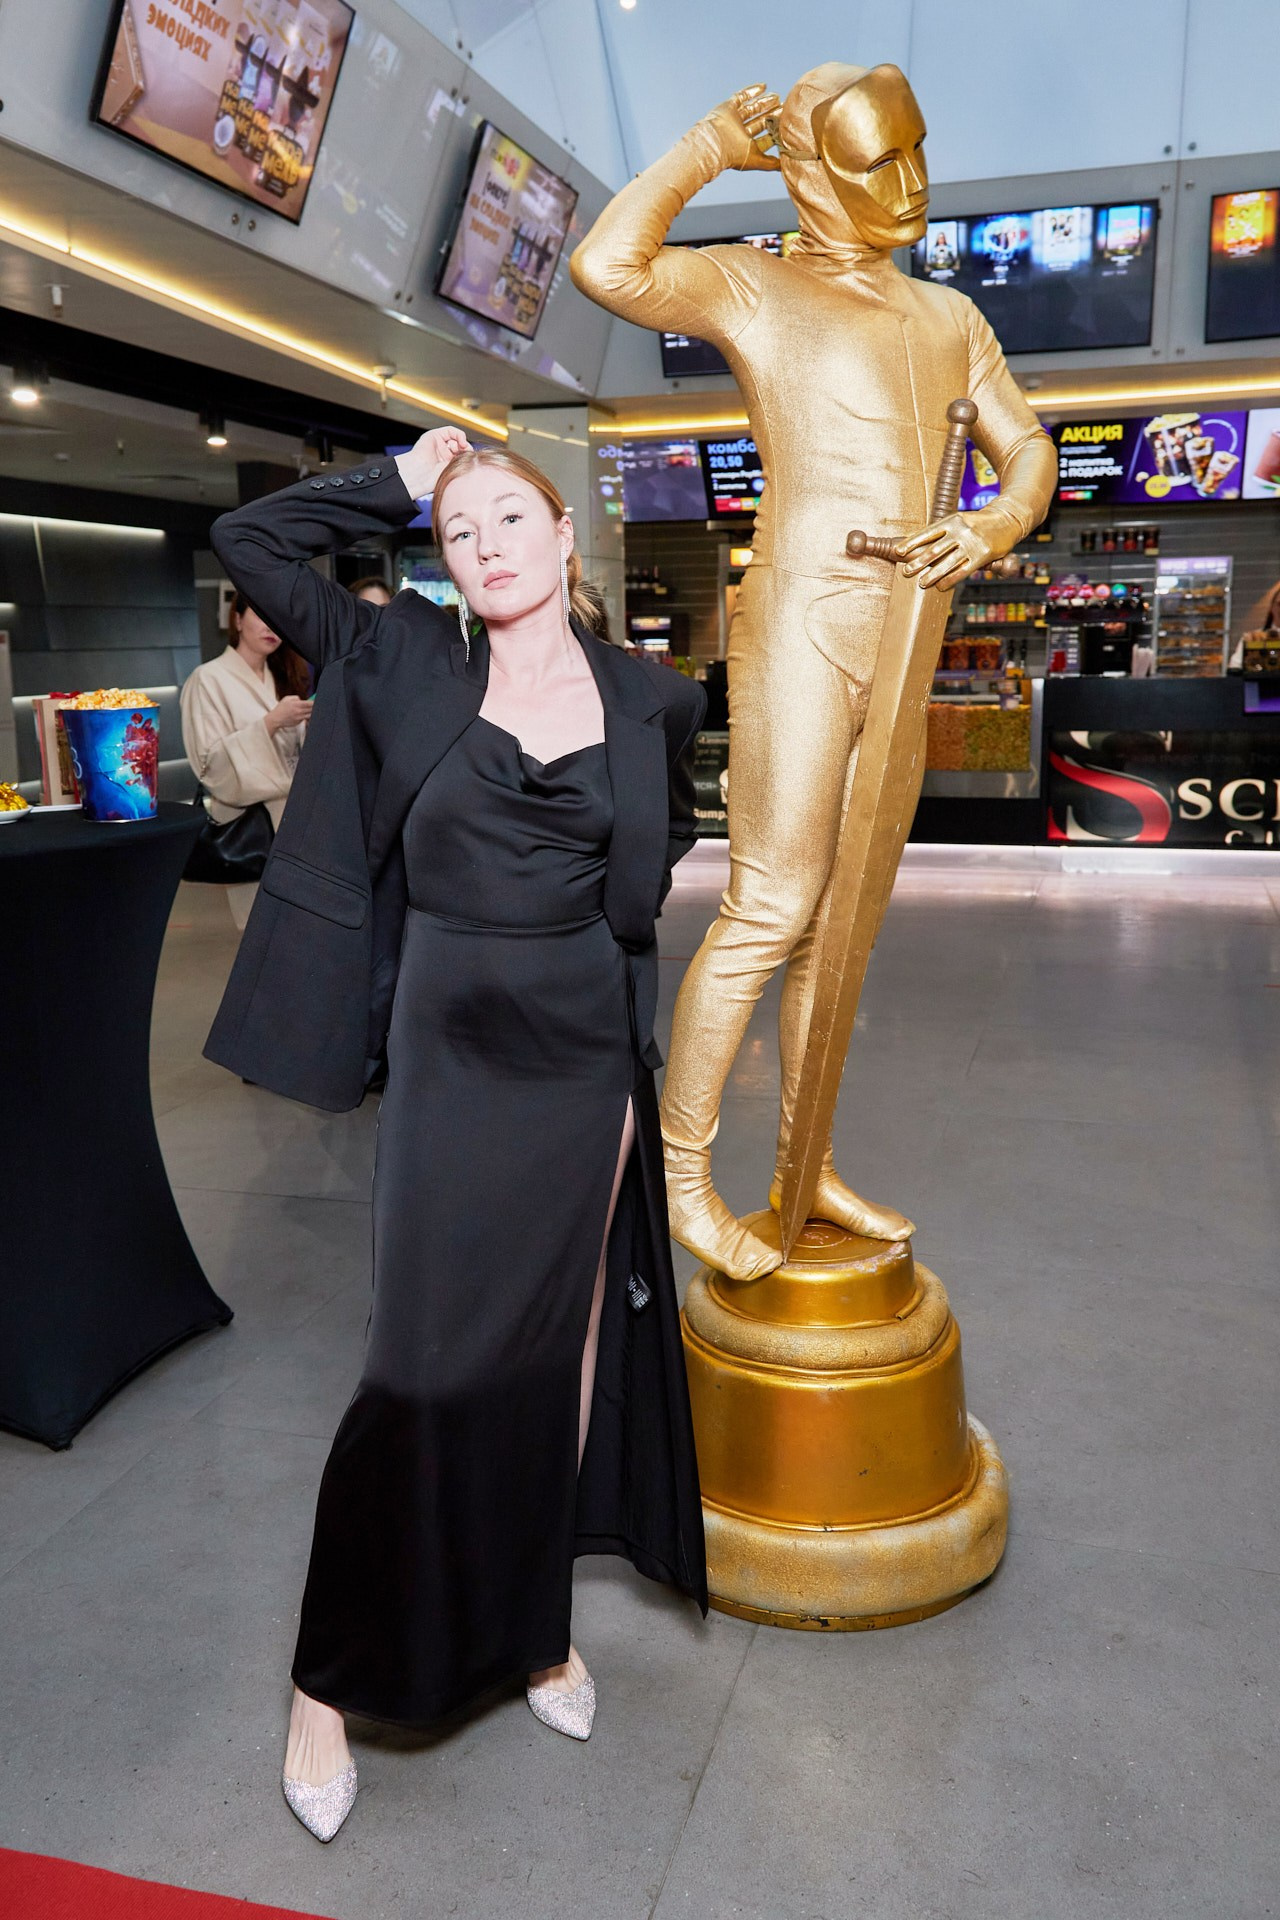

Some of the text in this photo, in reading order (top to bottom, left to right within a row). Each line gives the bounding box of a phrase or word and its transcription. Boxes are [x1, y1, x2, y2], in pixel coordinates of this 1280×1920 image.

[1060, 425, 1124, 444] АКЦИЯ
[709, 455, 744, 469] 20,50
[1068, 465, 1124, 478] ПОДАРОК
